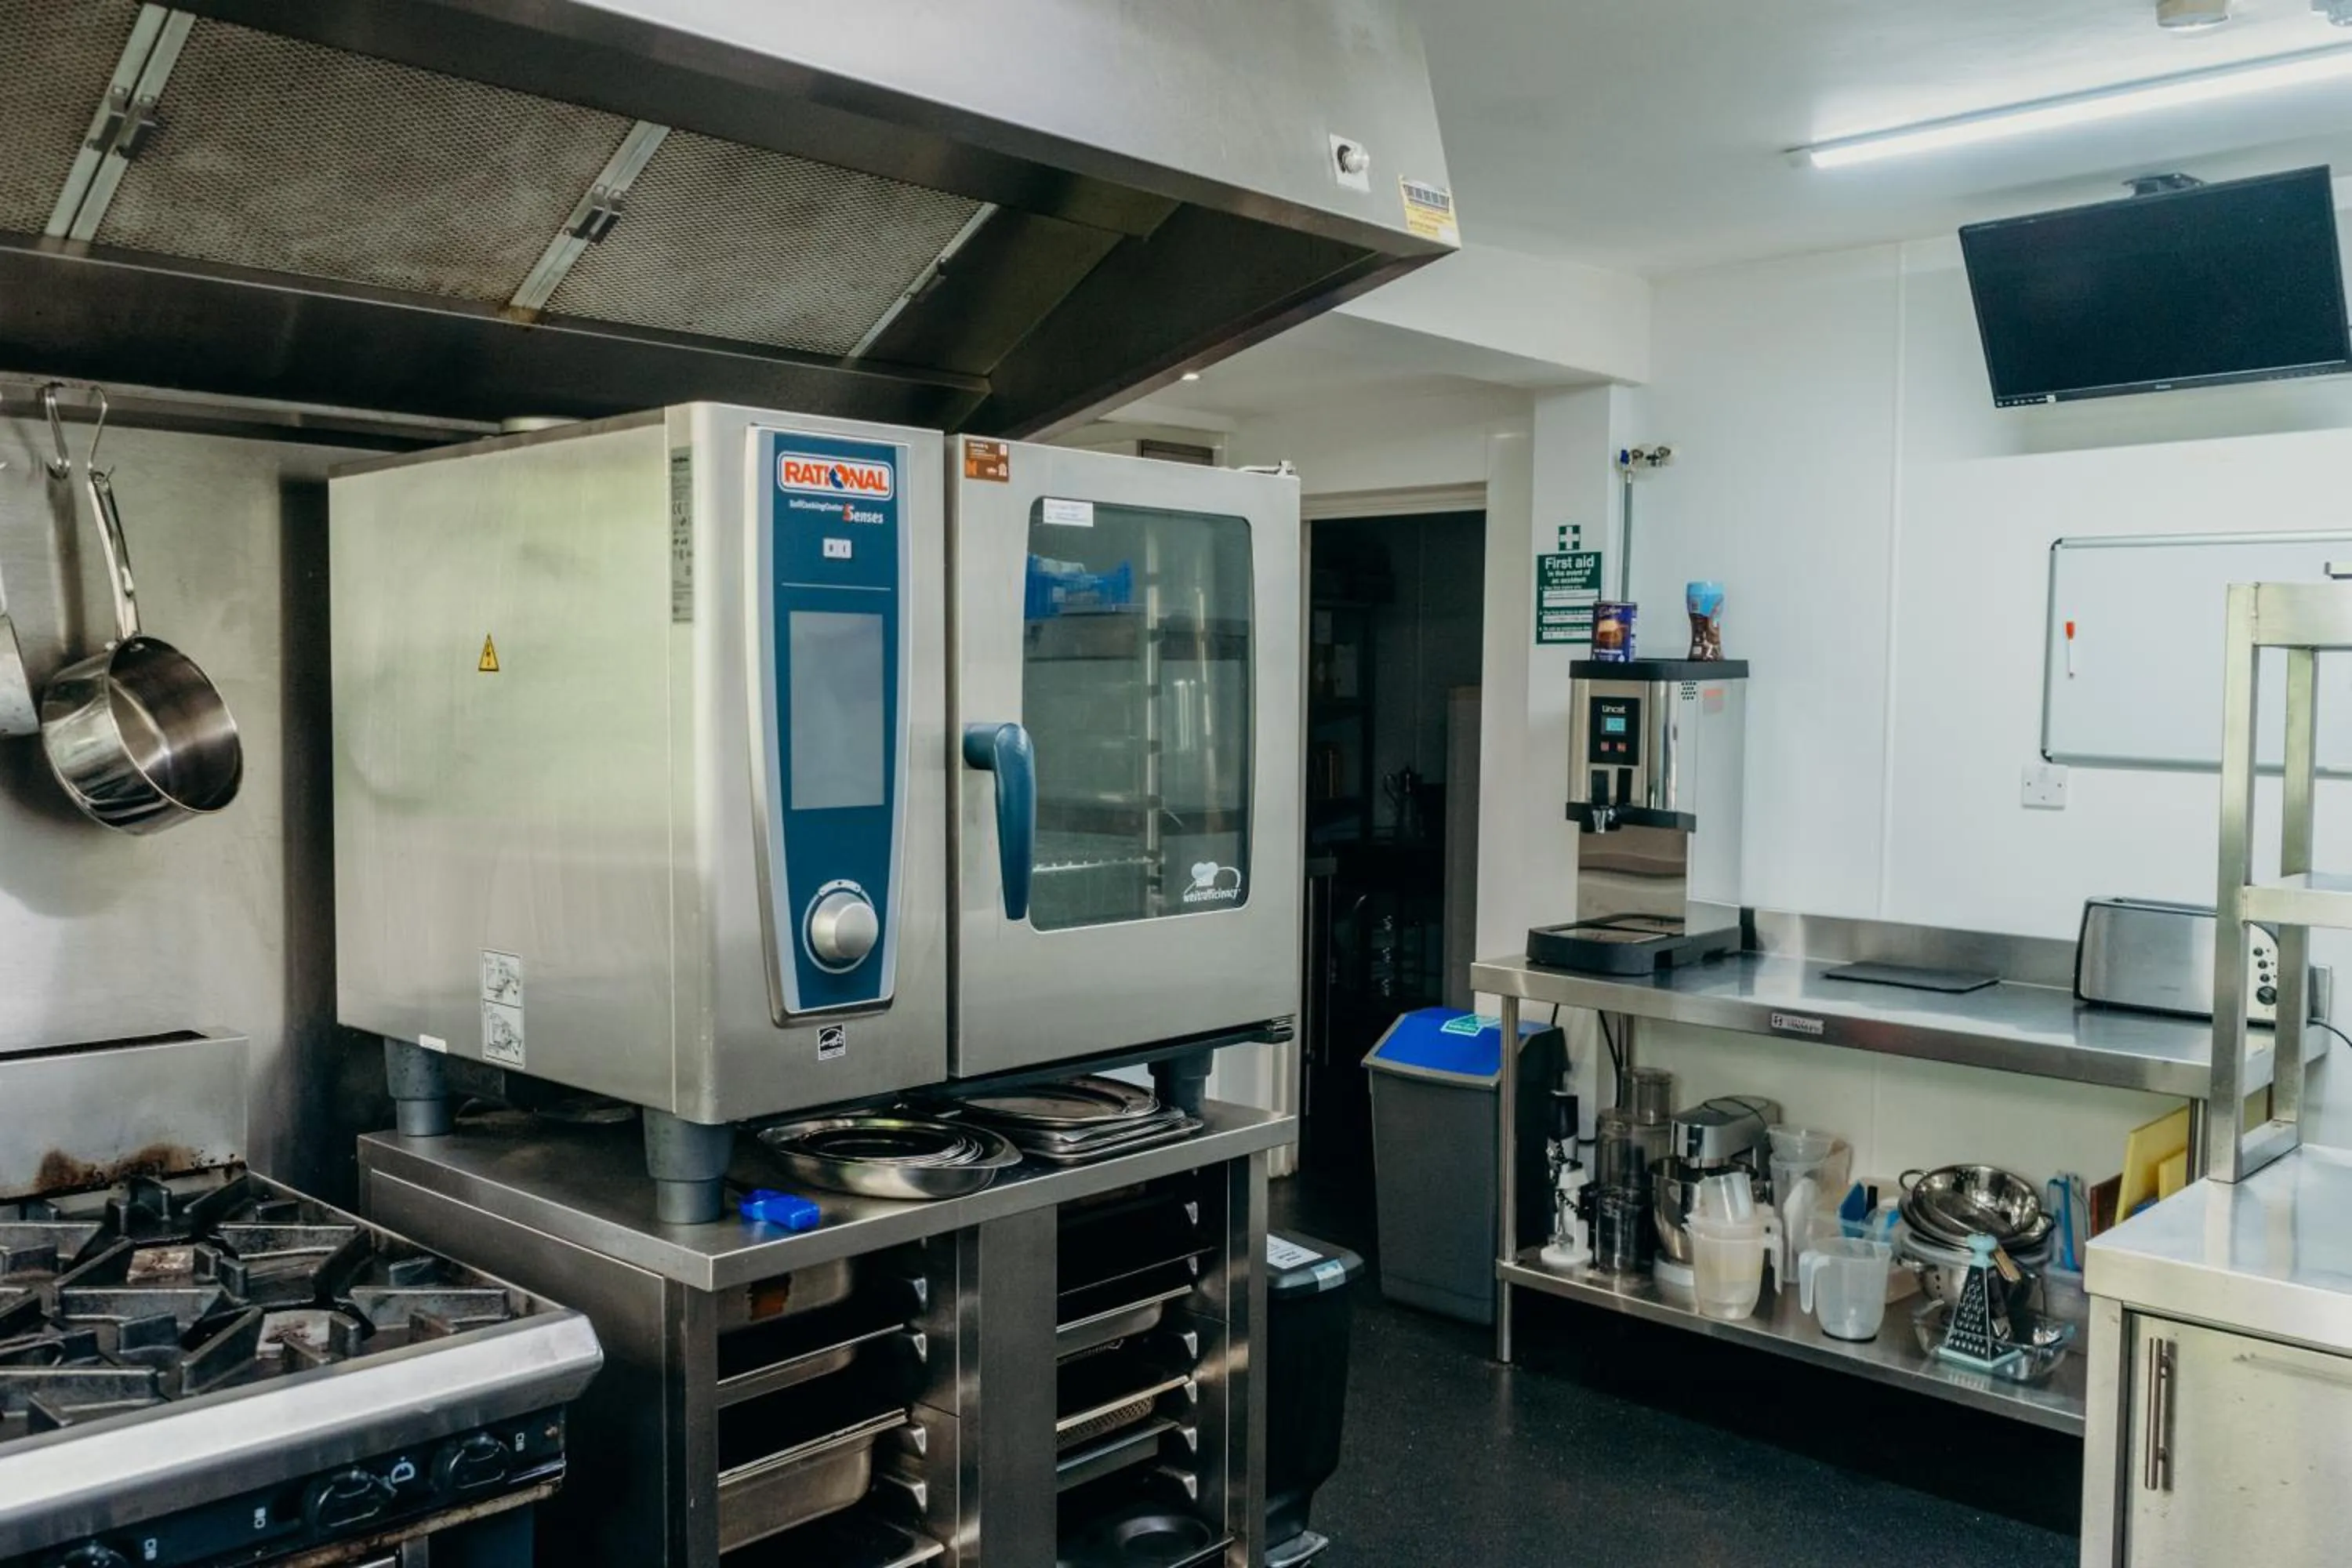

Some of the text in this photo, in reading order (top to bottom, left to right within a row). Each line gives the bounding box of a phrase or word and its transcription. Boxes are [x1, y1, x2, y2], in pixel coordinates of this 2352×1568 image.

[784, 461, 887, 492] RATIONAL
[1545, 555, 1595, 570] First aid
